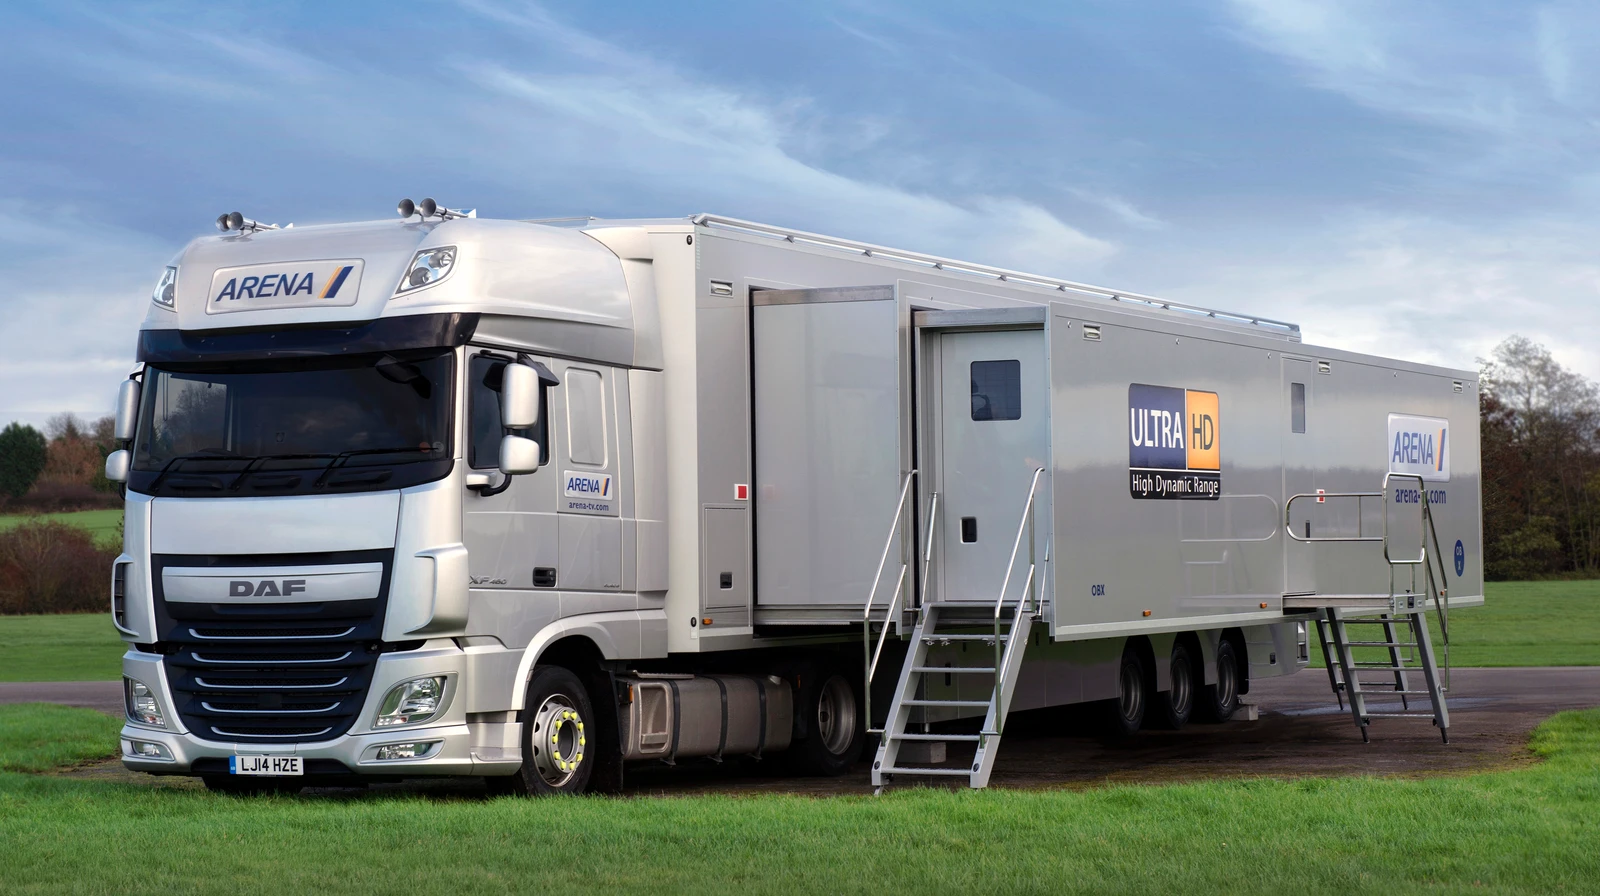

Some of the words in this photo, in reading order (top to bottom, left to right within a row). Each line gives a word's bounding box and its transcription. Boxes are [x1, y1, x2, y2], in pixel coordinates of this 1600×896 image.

[215, 272, 313, 302] ARENA
[1131, 408, 1184, 449] ULTRA
[1192, 413, 1214, 450] HD
[1392, 431, 1434, 465] ARENA
[567, 477, 600, 493] ARENA
[1132, 474, 1153, 496] High
[1156, 475, 1191, 496] Dynamic
[1194, 476, 1219, 497] Range
[1395, 489, 1447, 504] arena-.com
[569, 502, 609, 511] arena-tv.com
[229, 579, 306, 597] DAF
[1091, 584, 1105, 596] OBX
[241, 758, 269, 772] LJ14
[273, 758, 298, 772] HZE
